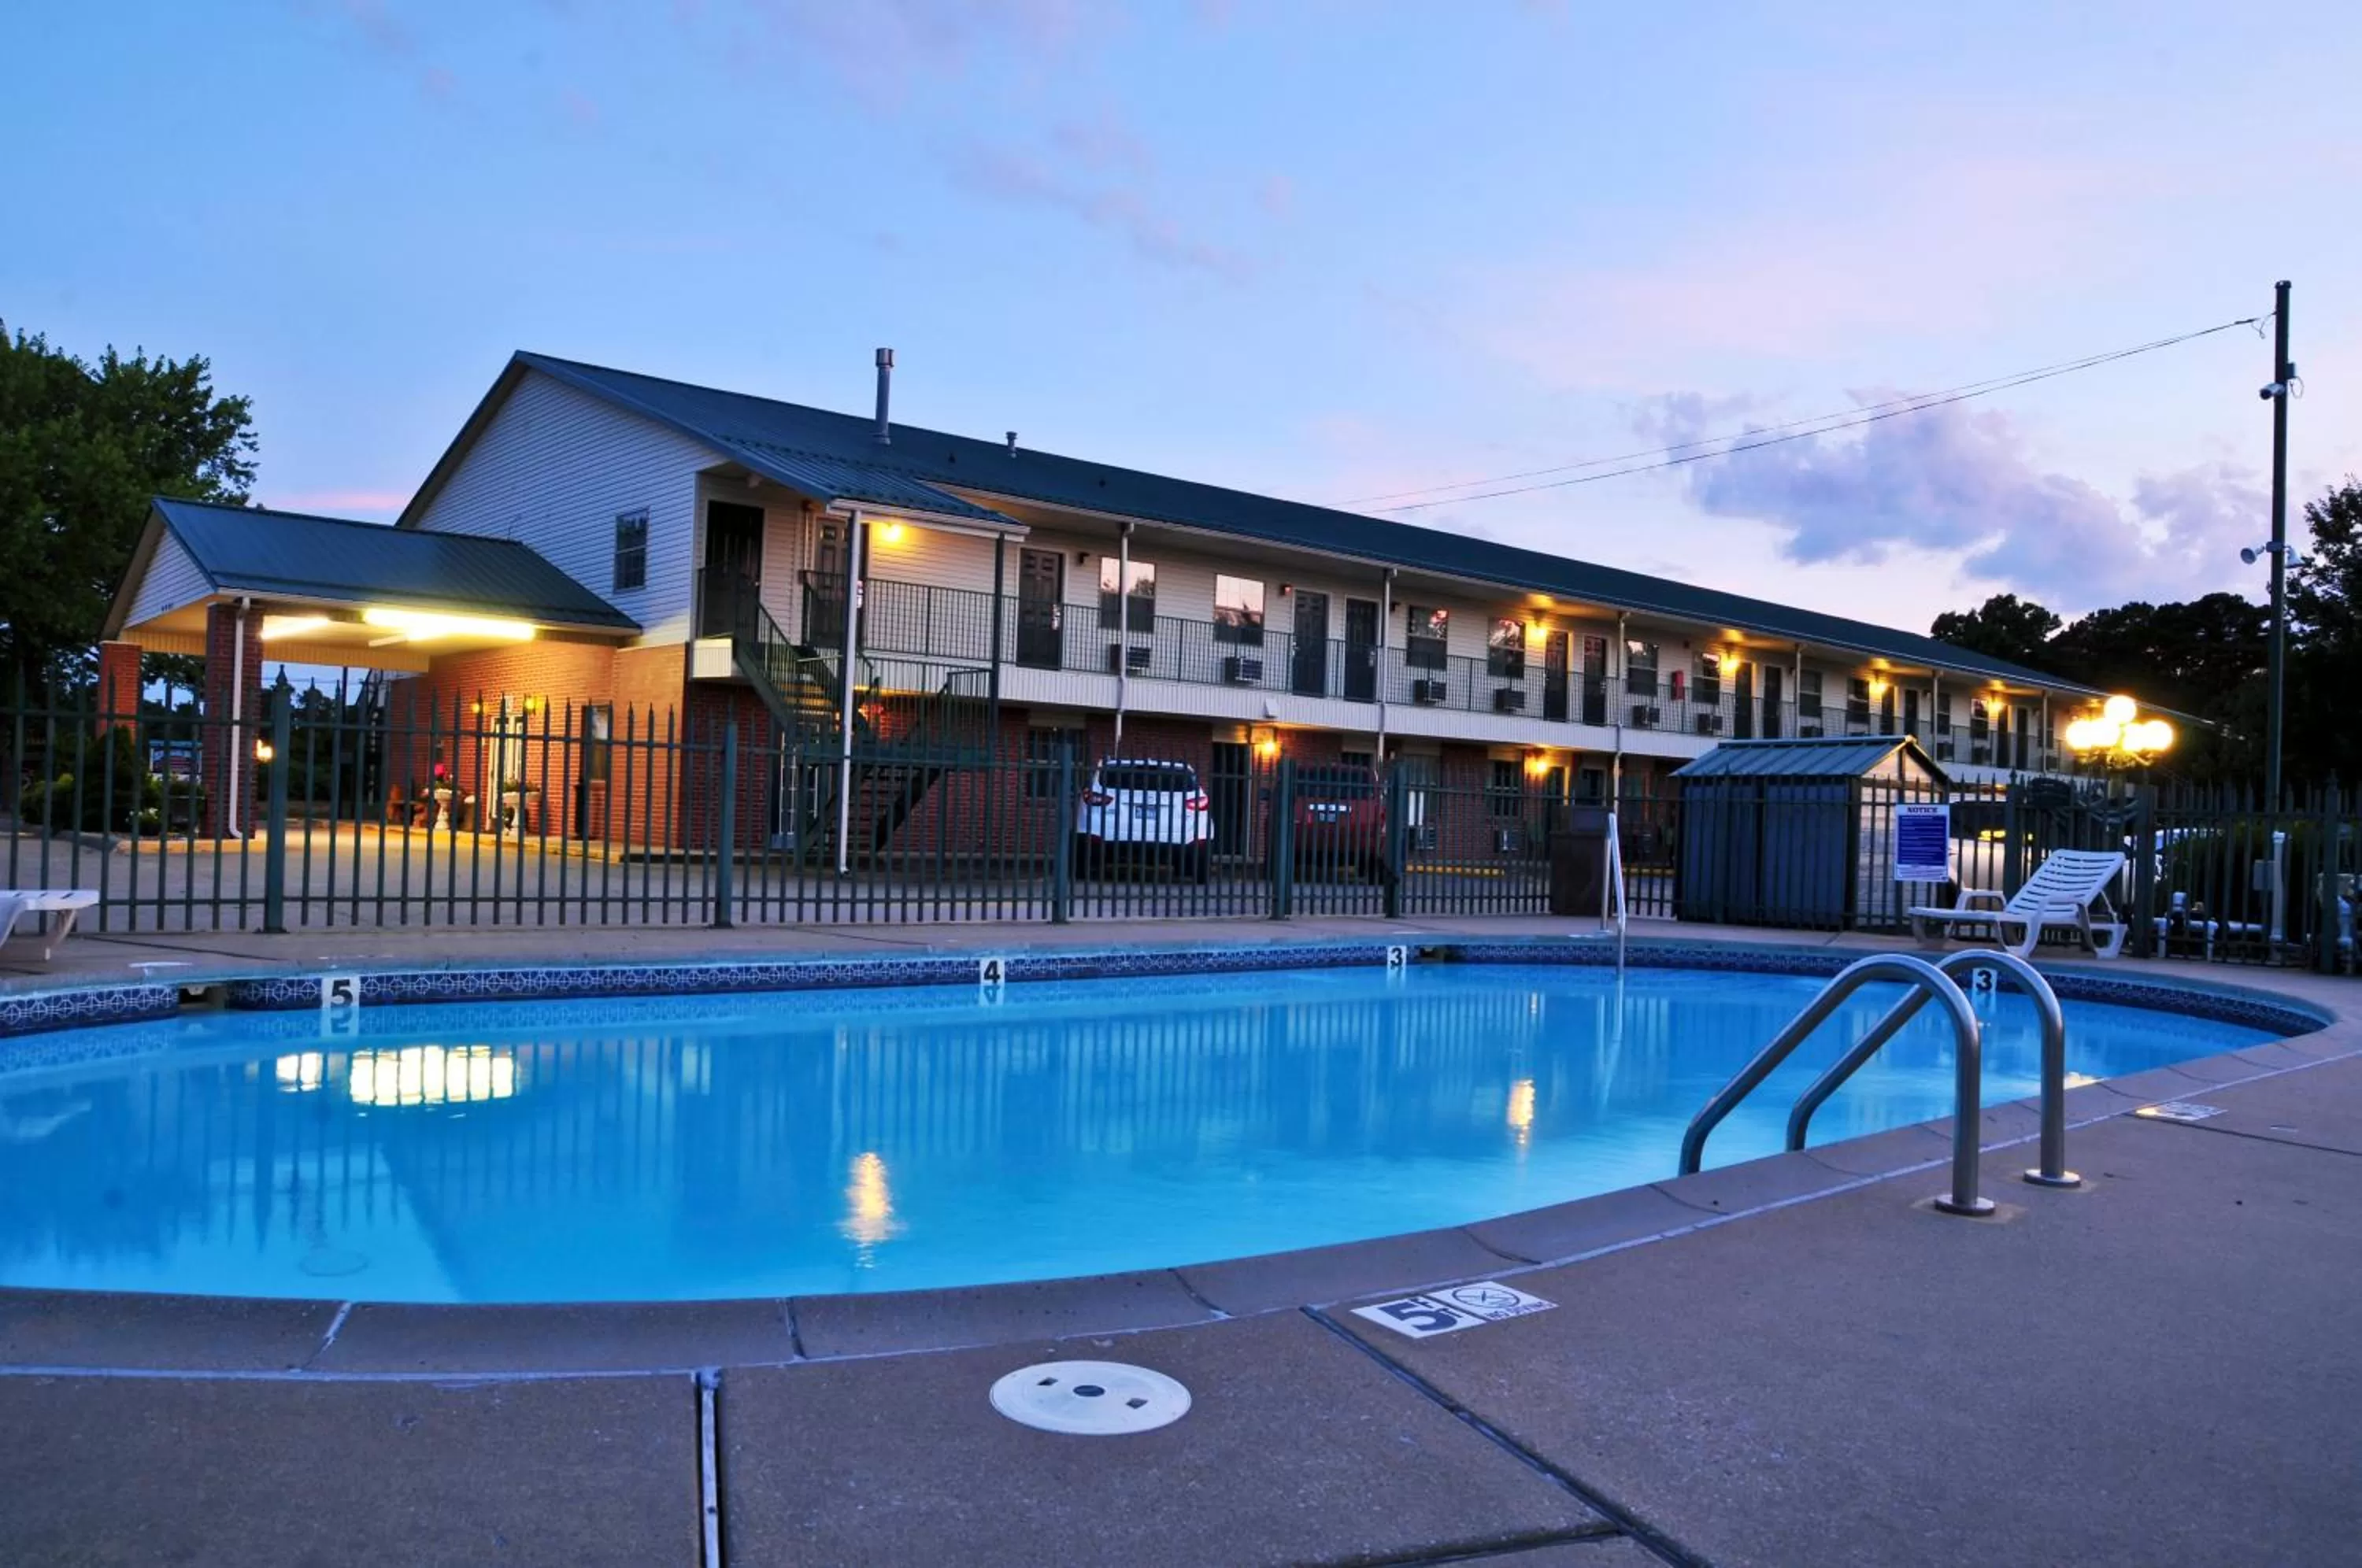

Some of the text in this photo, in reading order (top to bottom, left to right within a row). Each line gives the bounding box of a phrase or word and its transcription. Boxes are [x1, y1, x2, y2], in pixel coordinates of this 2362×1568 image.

[1390, 947, 1403, 967] 3
[984, 960, 1001, 984] 4
[1976, 969, 1992, 991] 3
[331, 979, 354, 1008] 5
[1378, 1301, 1457, 1331] 5
